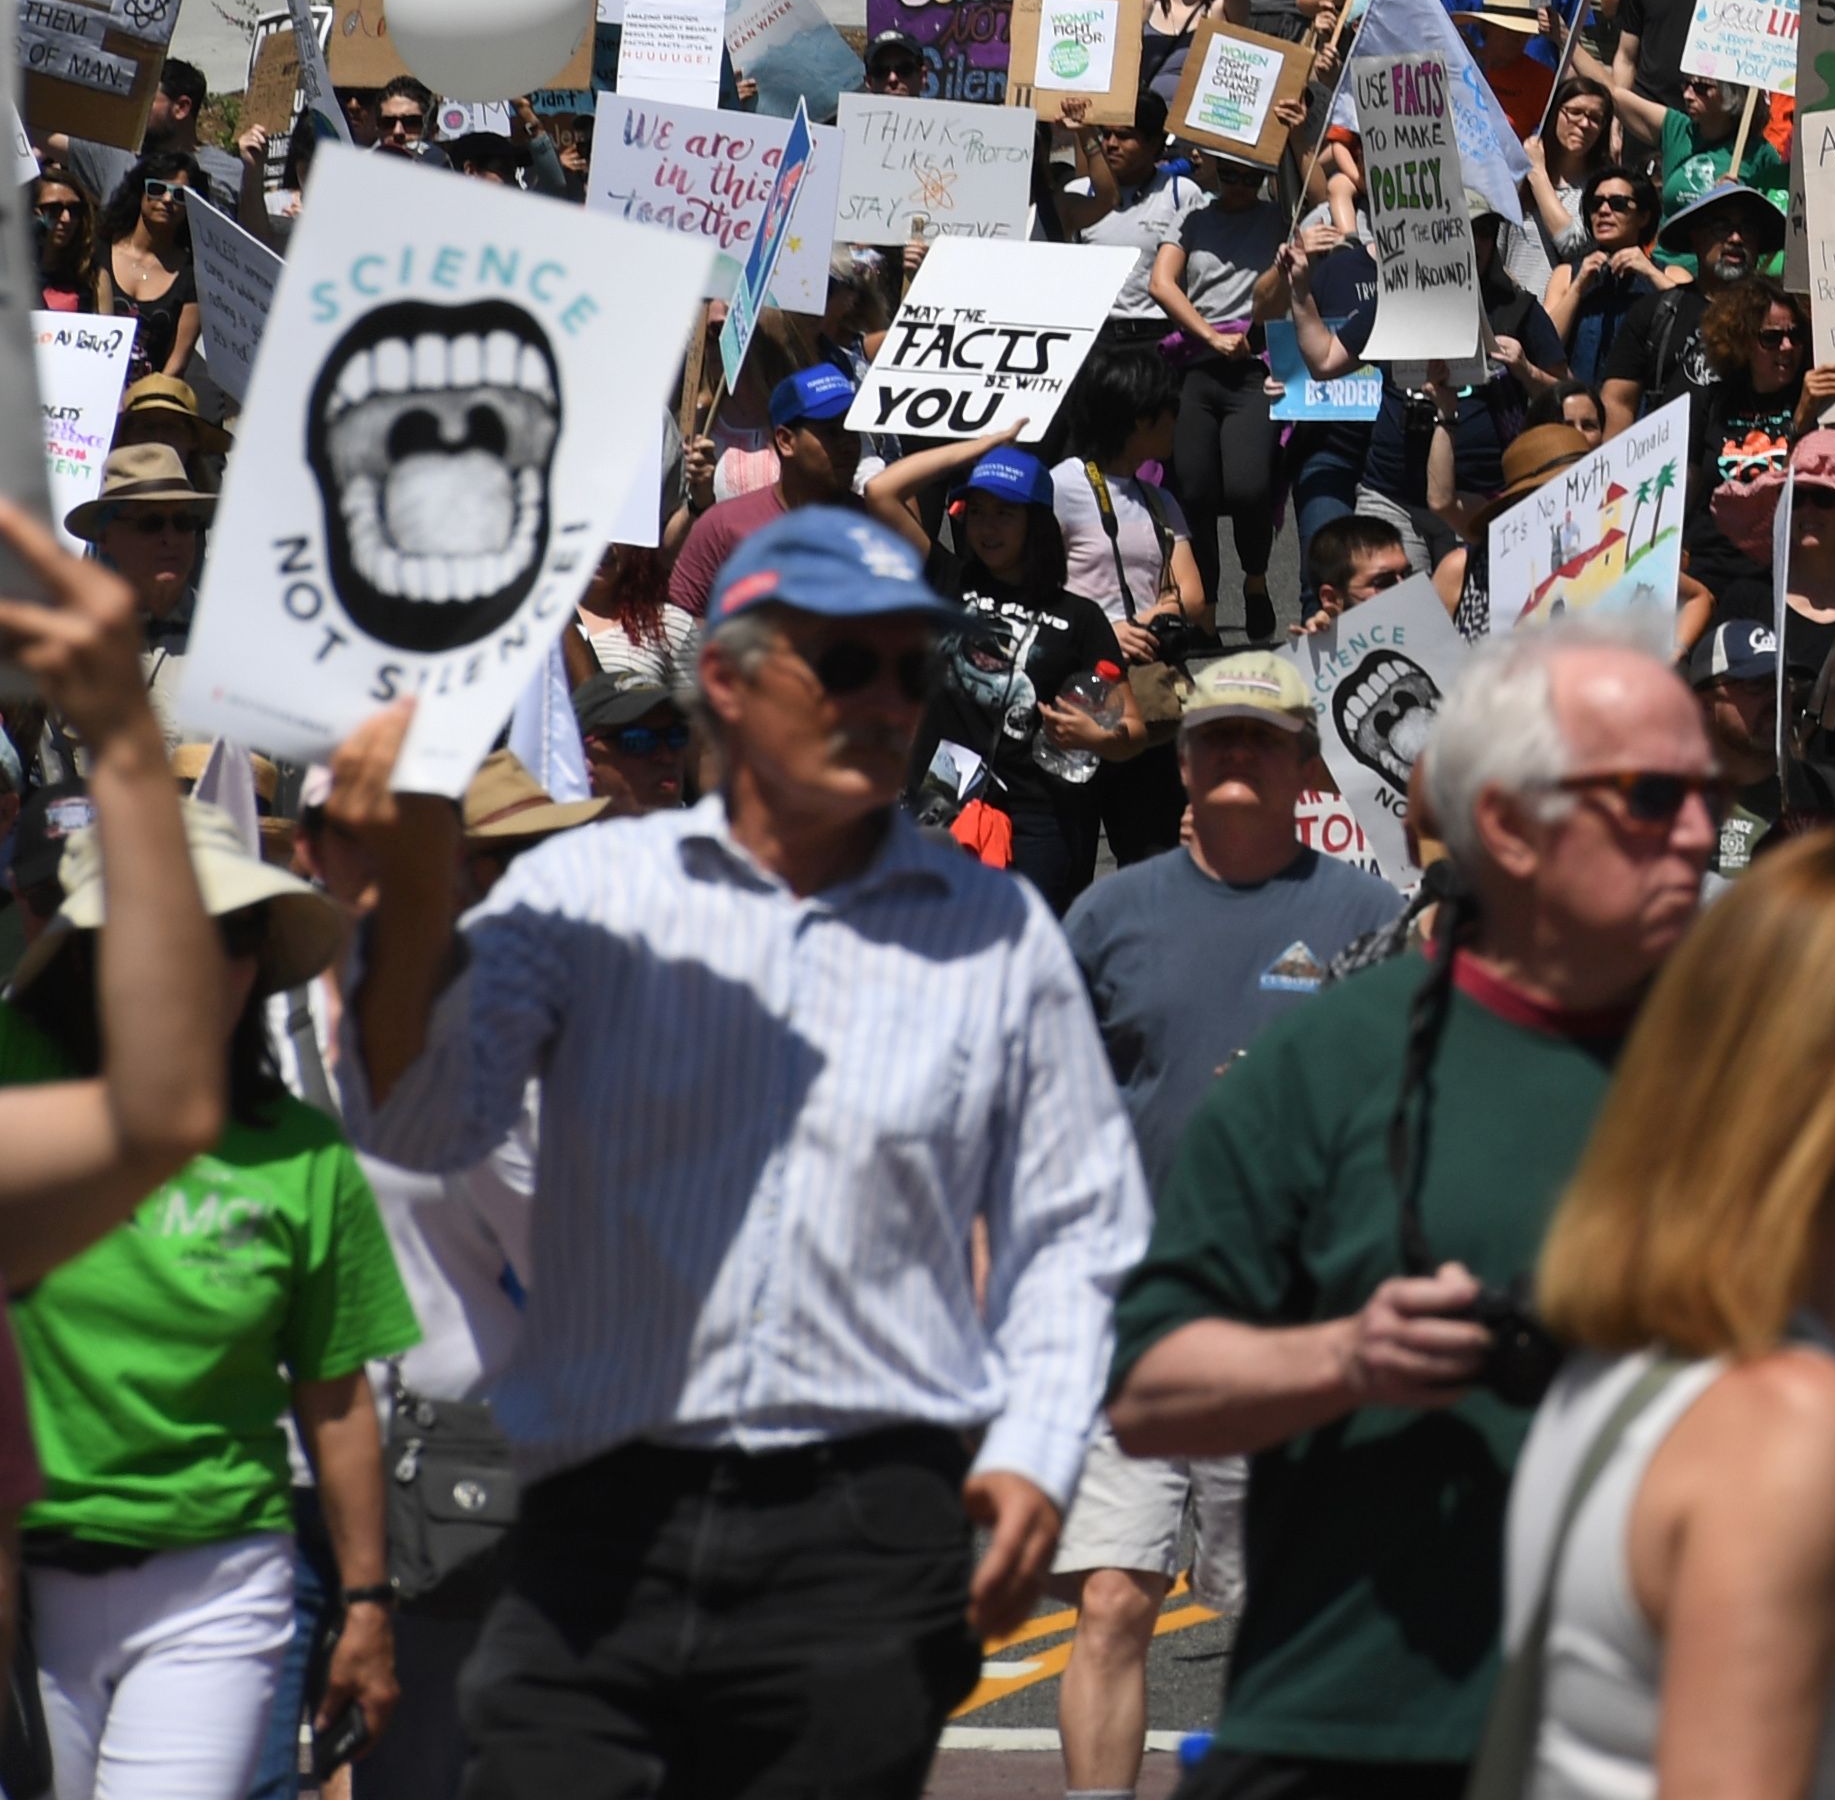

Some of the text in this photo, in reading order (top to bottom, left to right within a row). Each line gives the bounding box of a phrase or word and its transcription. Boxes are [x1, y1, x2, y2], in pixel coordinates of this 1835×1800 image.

[1357, 61, 1446, 118] USE FACTS
[1365, 122, 1446, 152] TO MAKE
[1369, 157, 1451, 217] POLICY,
[1377, 216, 1466, 259] NOT THE OTHER
[311, 243, 600, 337] SCIENCE
[1382, 252, 1473, 294] WAY AROUND!
[902, 304, 989, 324] MAY THE
[891, 320, 1071, 375] FACTS
[984, 375, 1063, 394] BE WITH
[873, 386, 1005, 432] YOU
[272, 535, 349, 664] NOT
